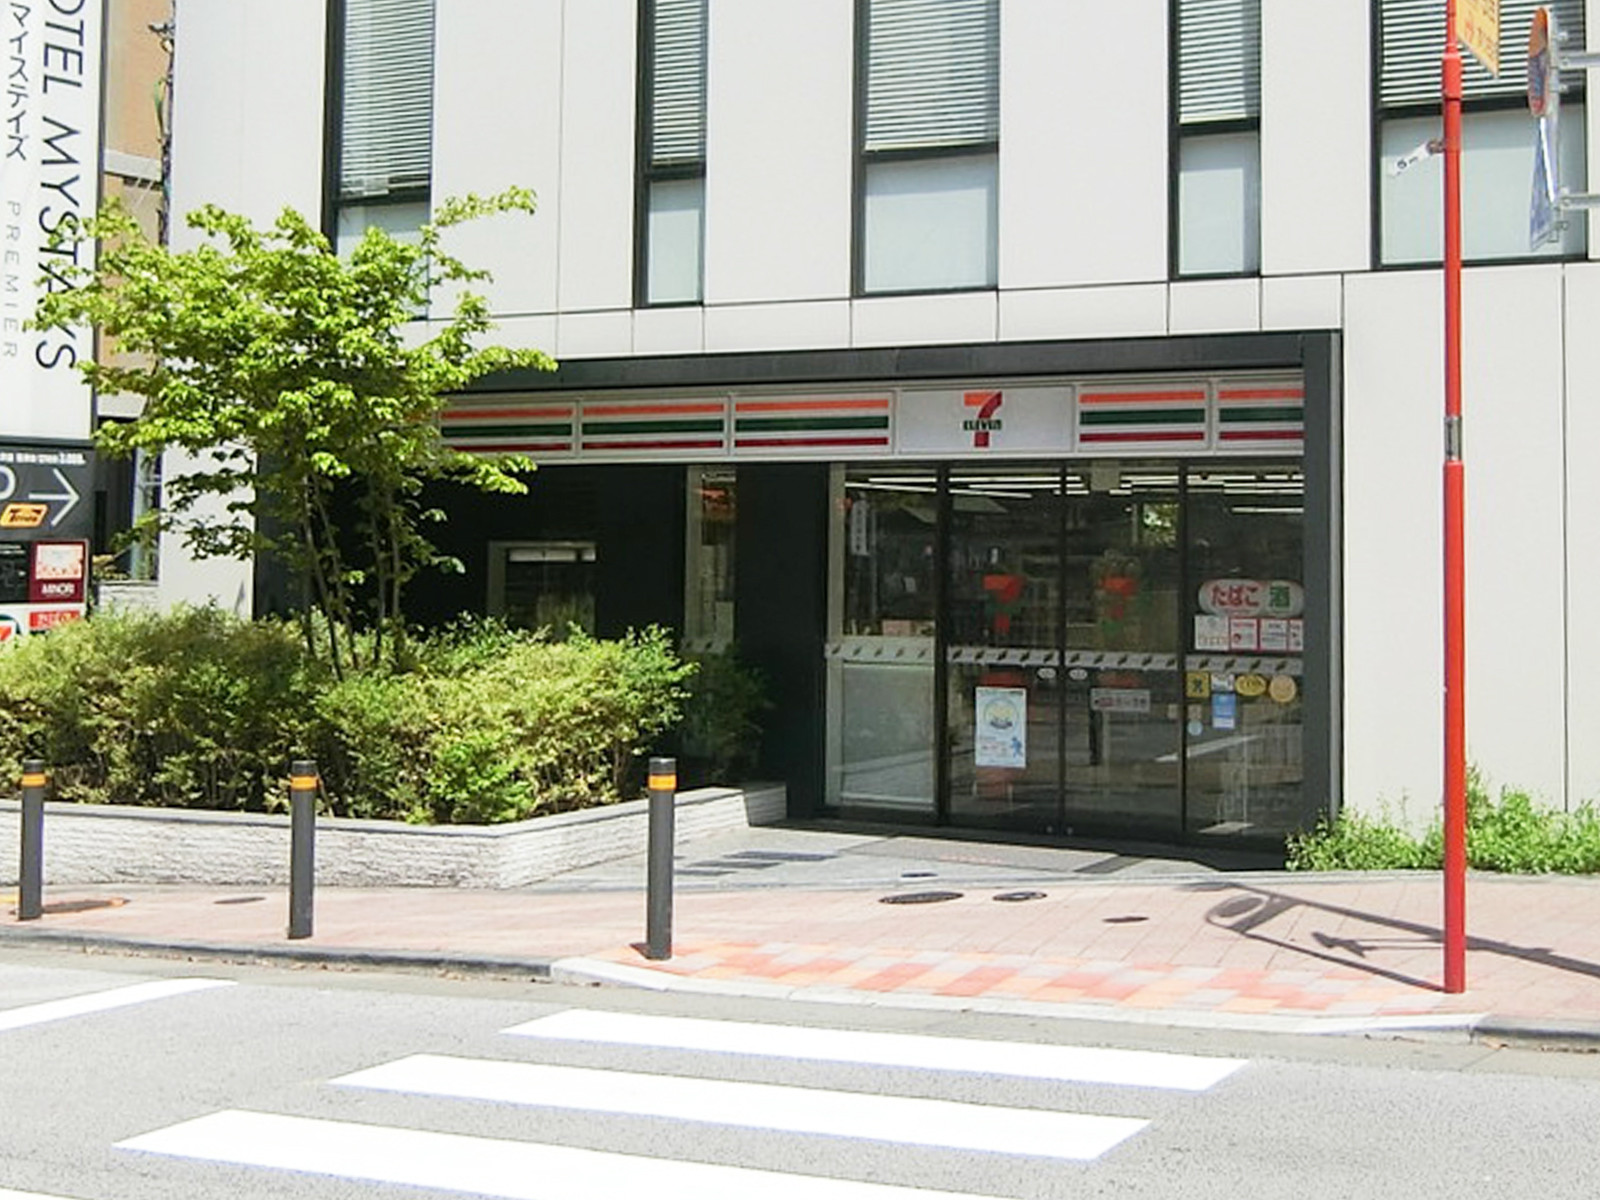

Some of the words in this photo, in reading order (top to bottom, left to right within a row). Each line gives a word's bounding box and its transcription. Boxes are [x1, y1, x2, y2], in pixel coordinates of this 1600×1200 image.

[4, 200, 22, 358] PREMIER
[963, 390, 1003, 448] 7
[1211, 584, 1260, 607] たばこ
